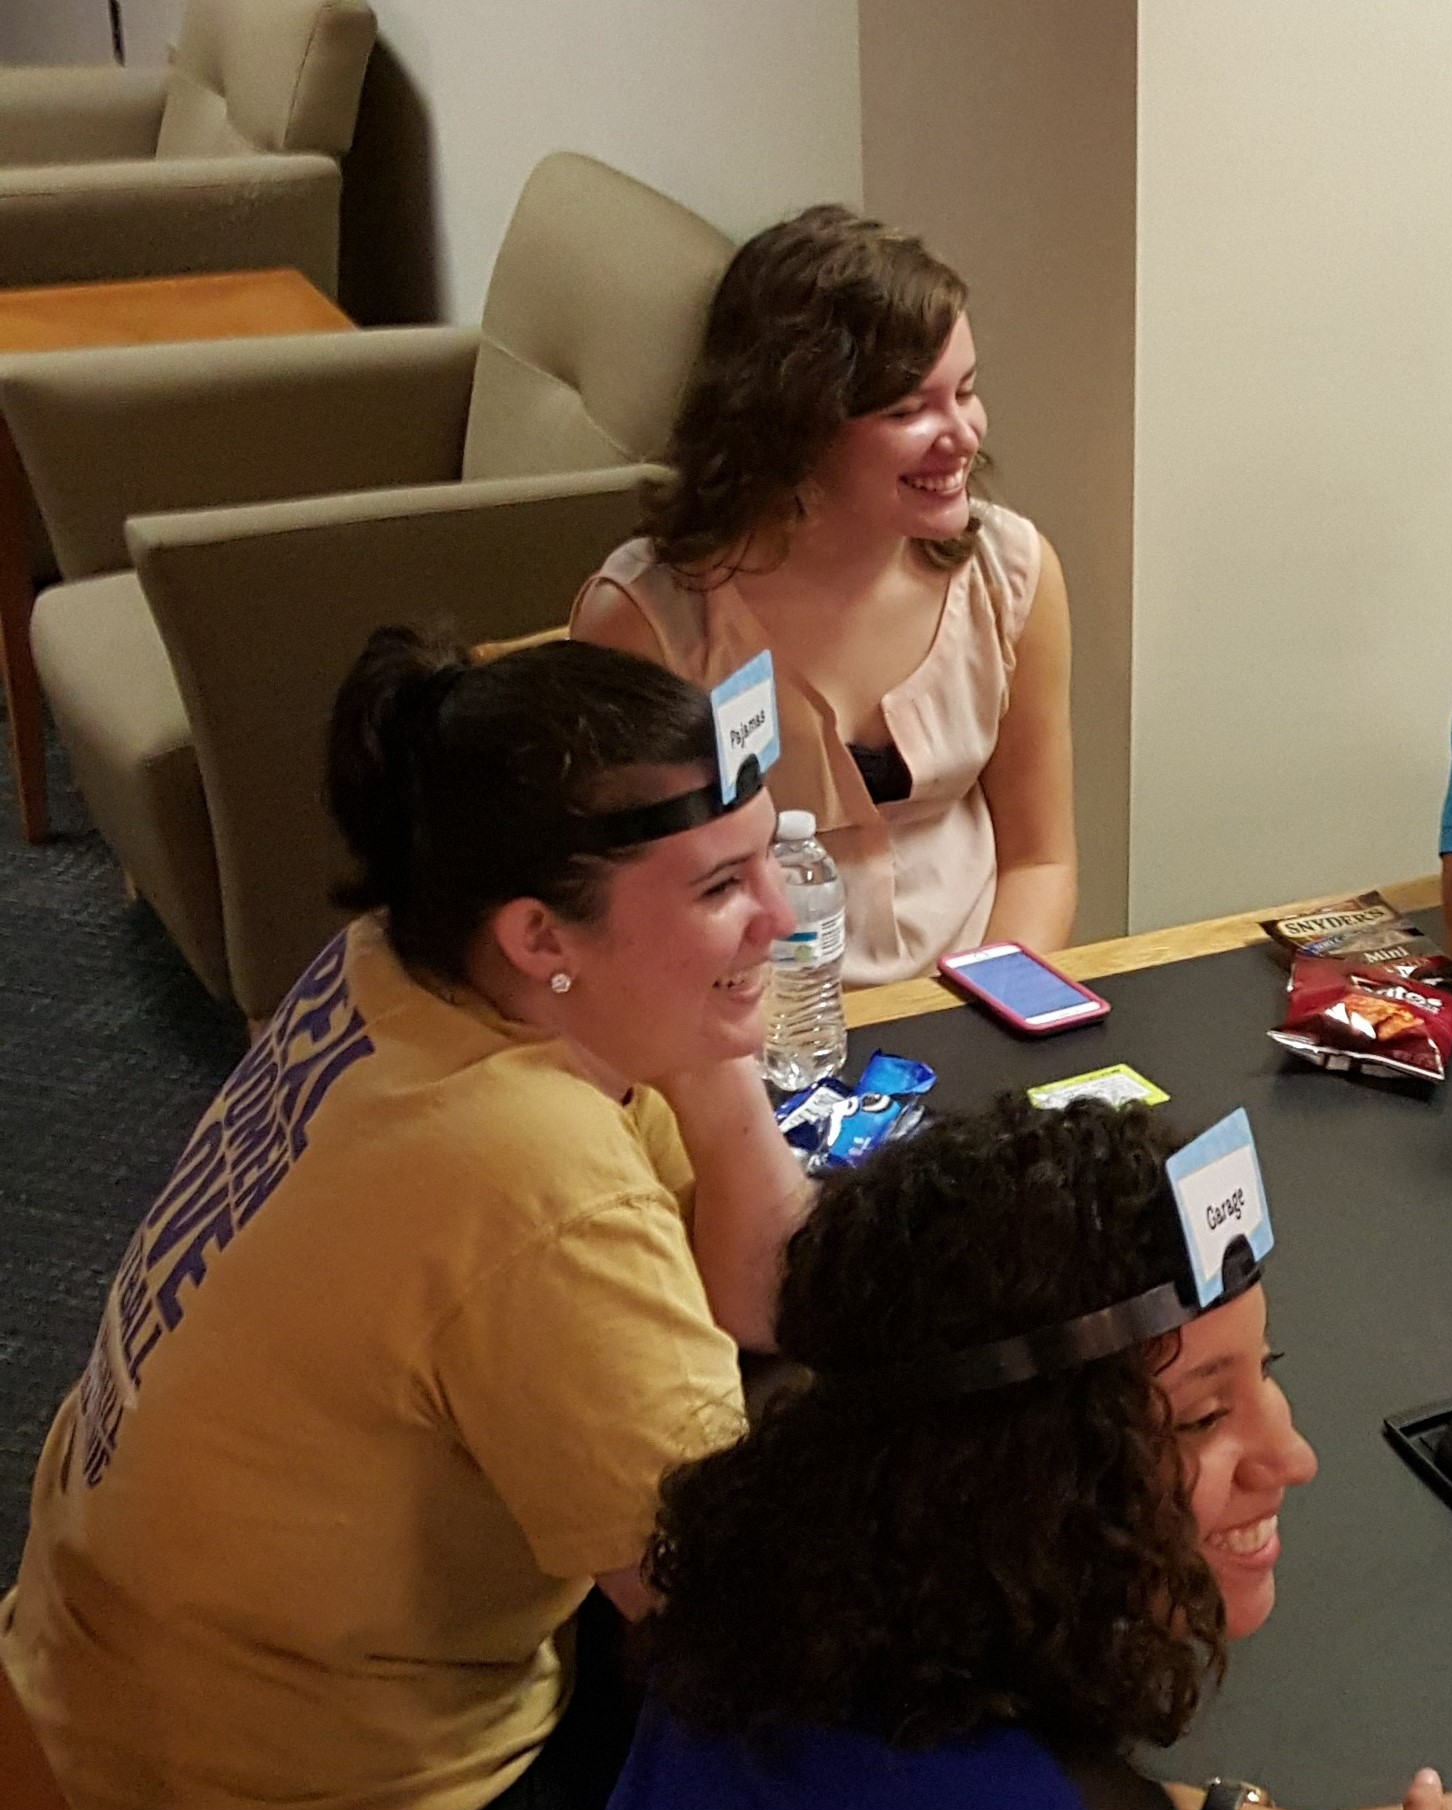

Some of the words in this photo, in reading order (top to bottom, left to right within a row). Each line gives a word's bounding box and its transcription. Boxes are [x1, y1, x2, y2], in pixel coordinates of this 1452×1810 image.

[729, 709, 766, 749] Pajamas
[1363, 945, 1409, 964] Mini
[146, 1119, 236, 1333] OVE
[1205, 1187, 1246, 1231] Garage
